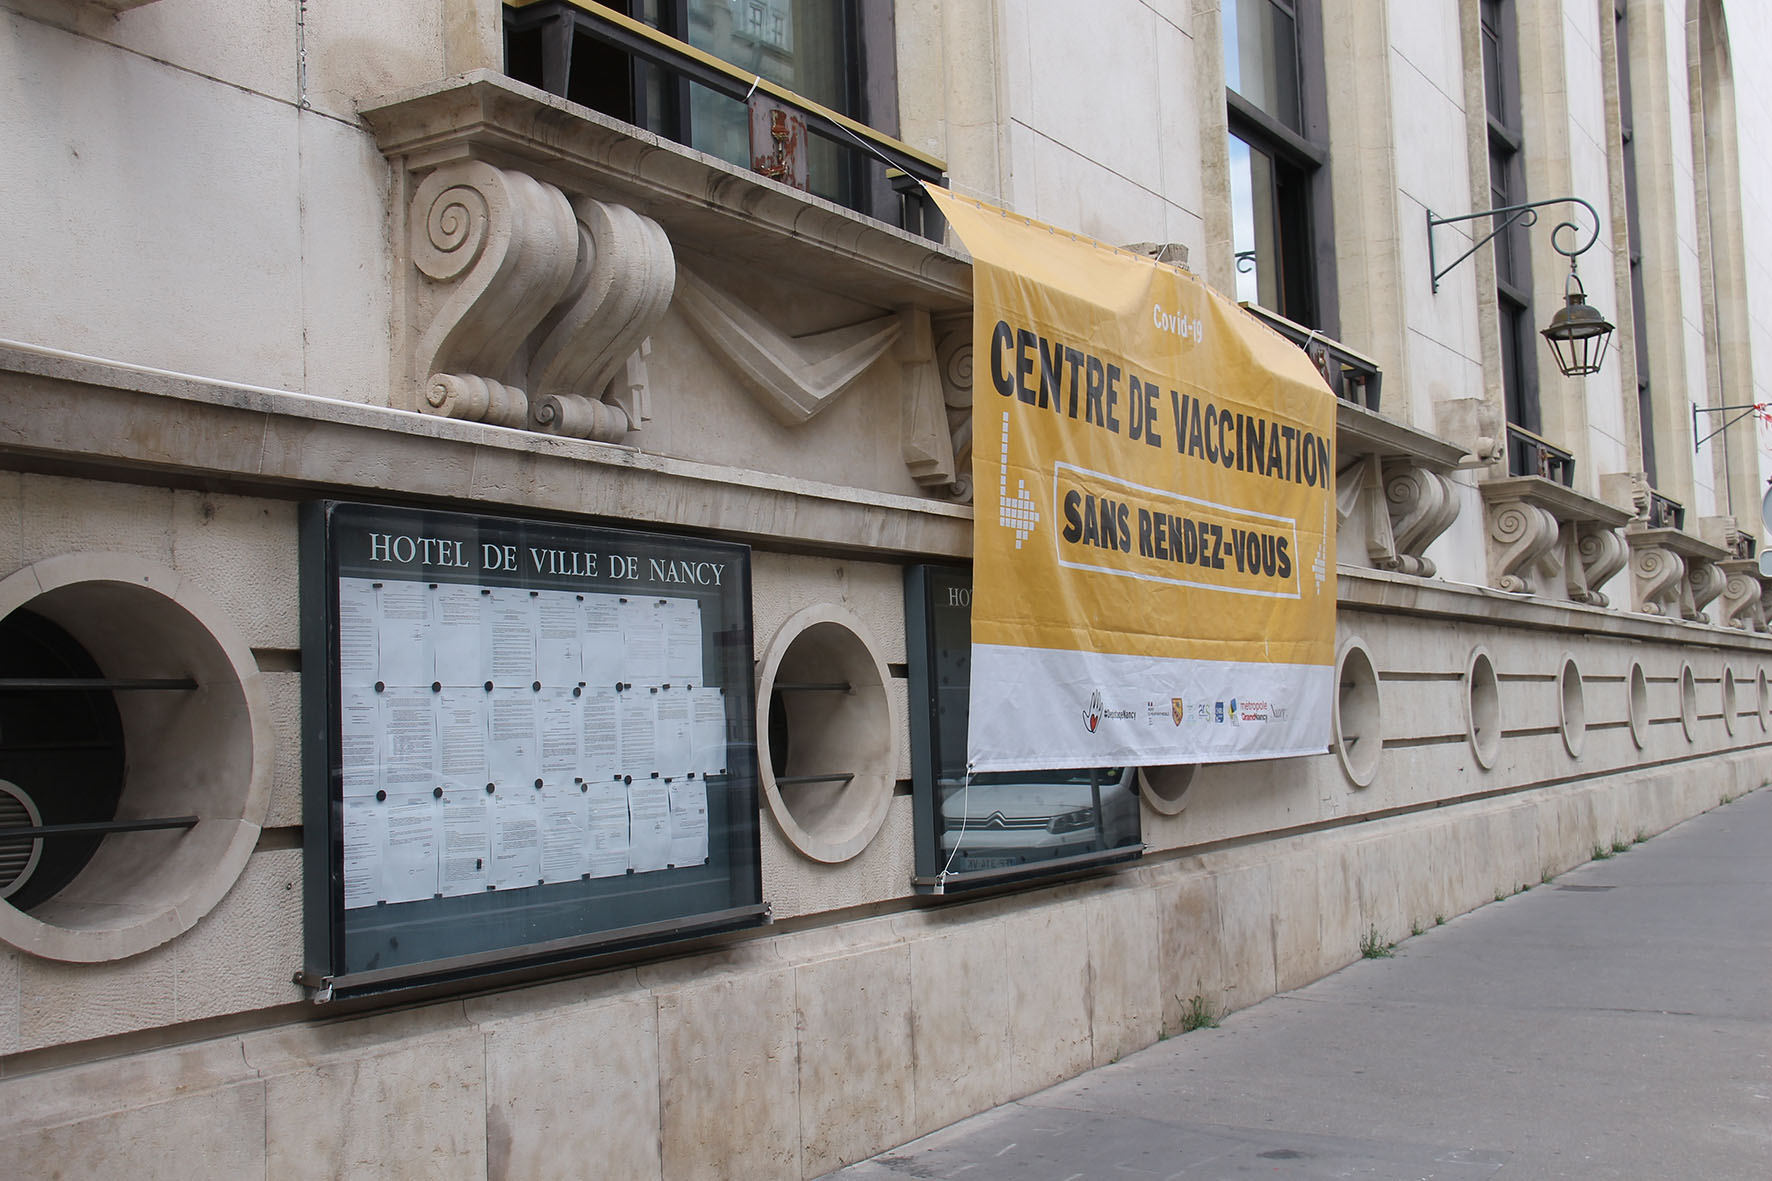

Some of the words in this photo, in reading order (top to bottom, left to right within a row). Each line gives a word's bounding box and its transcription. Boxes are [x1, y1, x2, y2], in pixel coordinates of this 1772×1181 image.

[1153, 303, 1202, 344] Covid-19
[990, 320, 1121, 434] CENTRE
[1129, 374, 1161, 448] DE
[1170, 390, 1330, 491] VACCINATION
[369, 532, 470, 568] HOTEL
[482, 543, 518, 572] DE
[529, 547, 598, 577] VILLE
[609, 554, 639, 580] DE
[649, 558, 725, 586] NANCY
[1062, 490, 1131, 553] SANS
[1138, 508, 1291, 578] RENDEZ-VOUS
